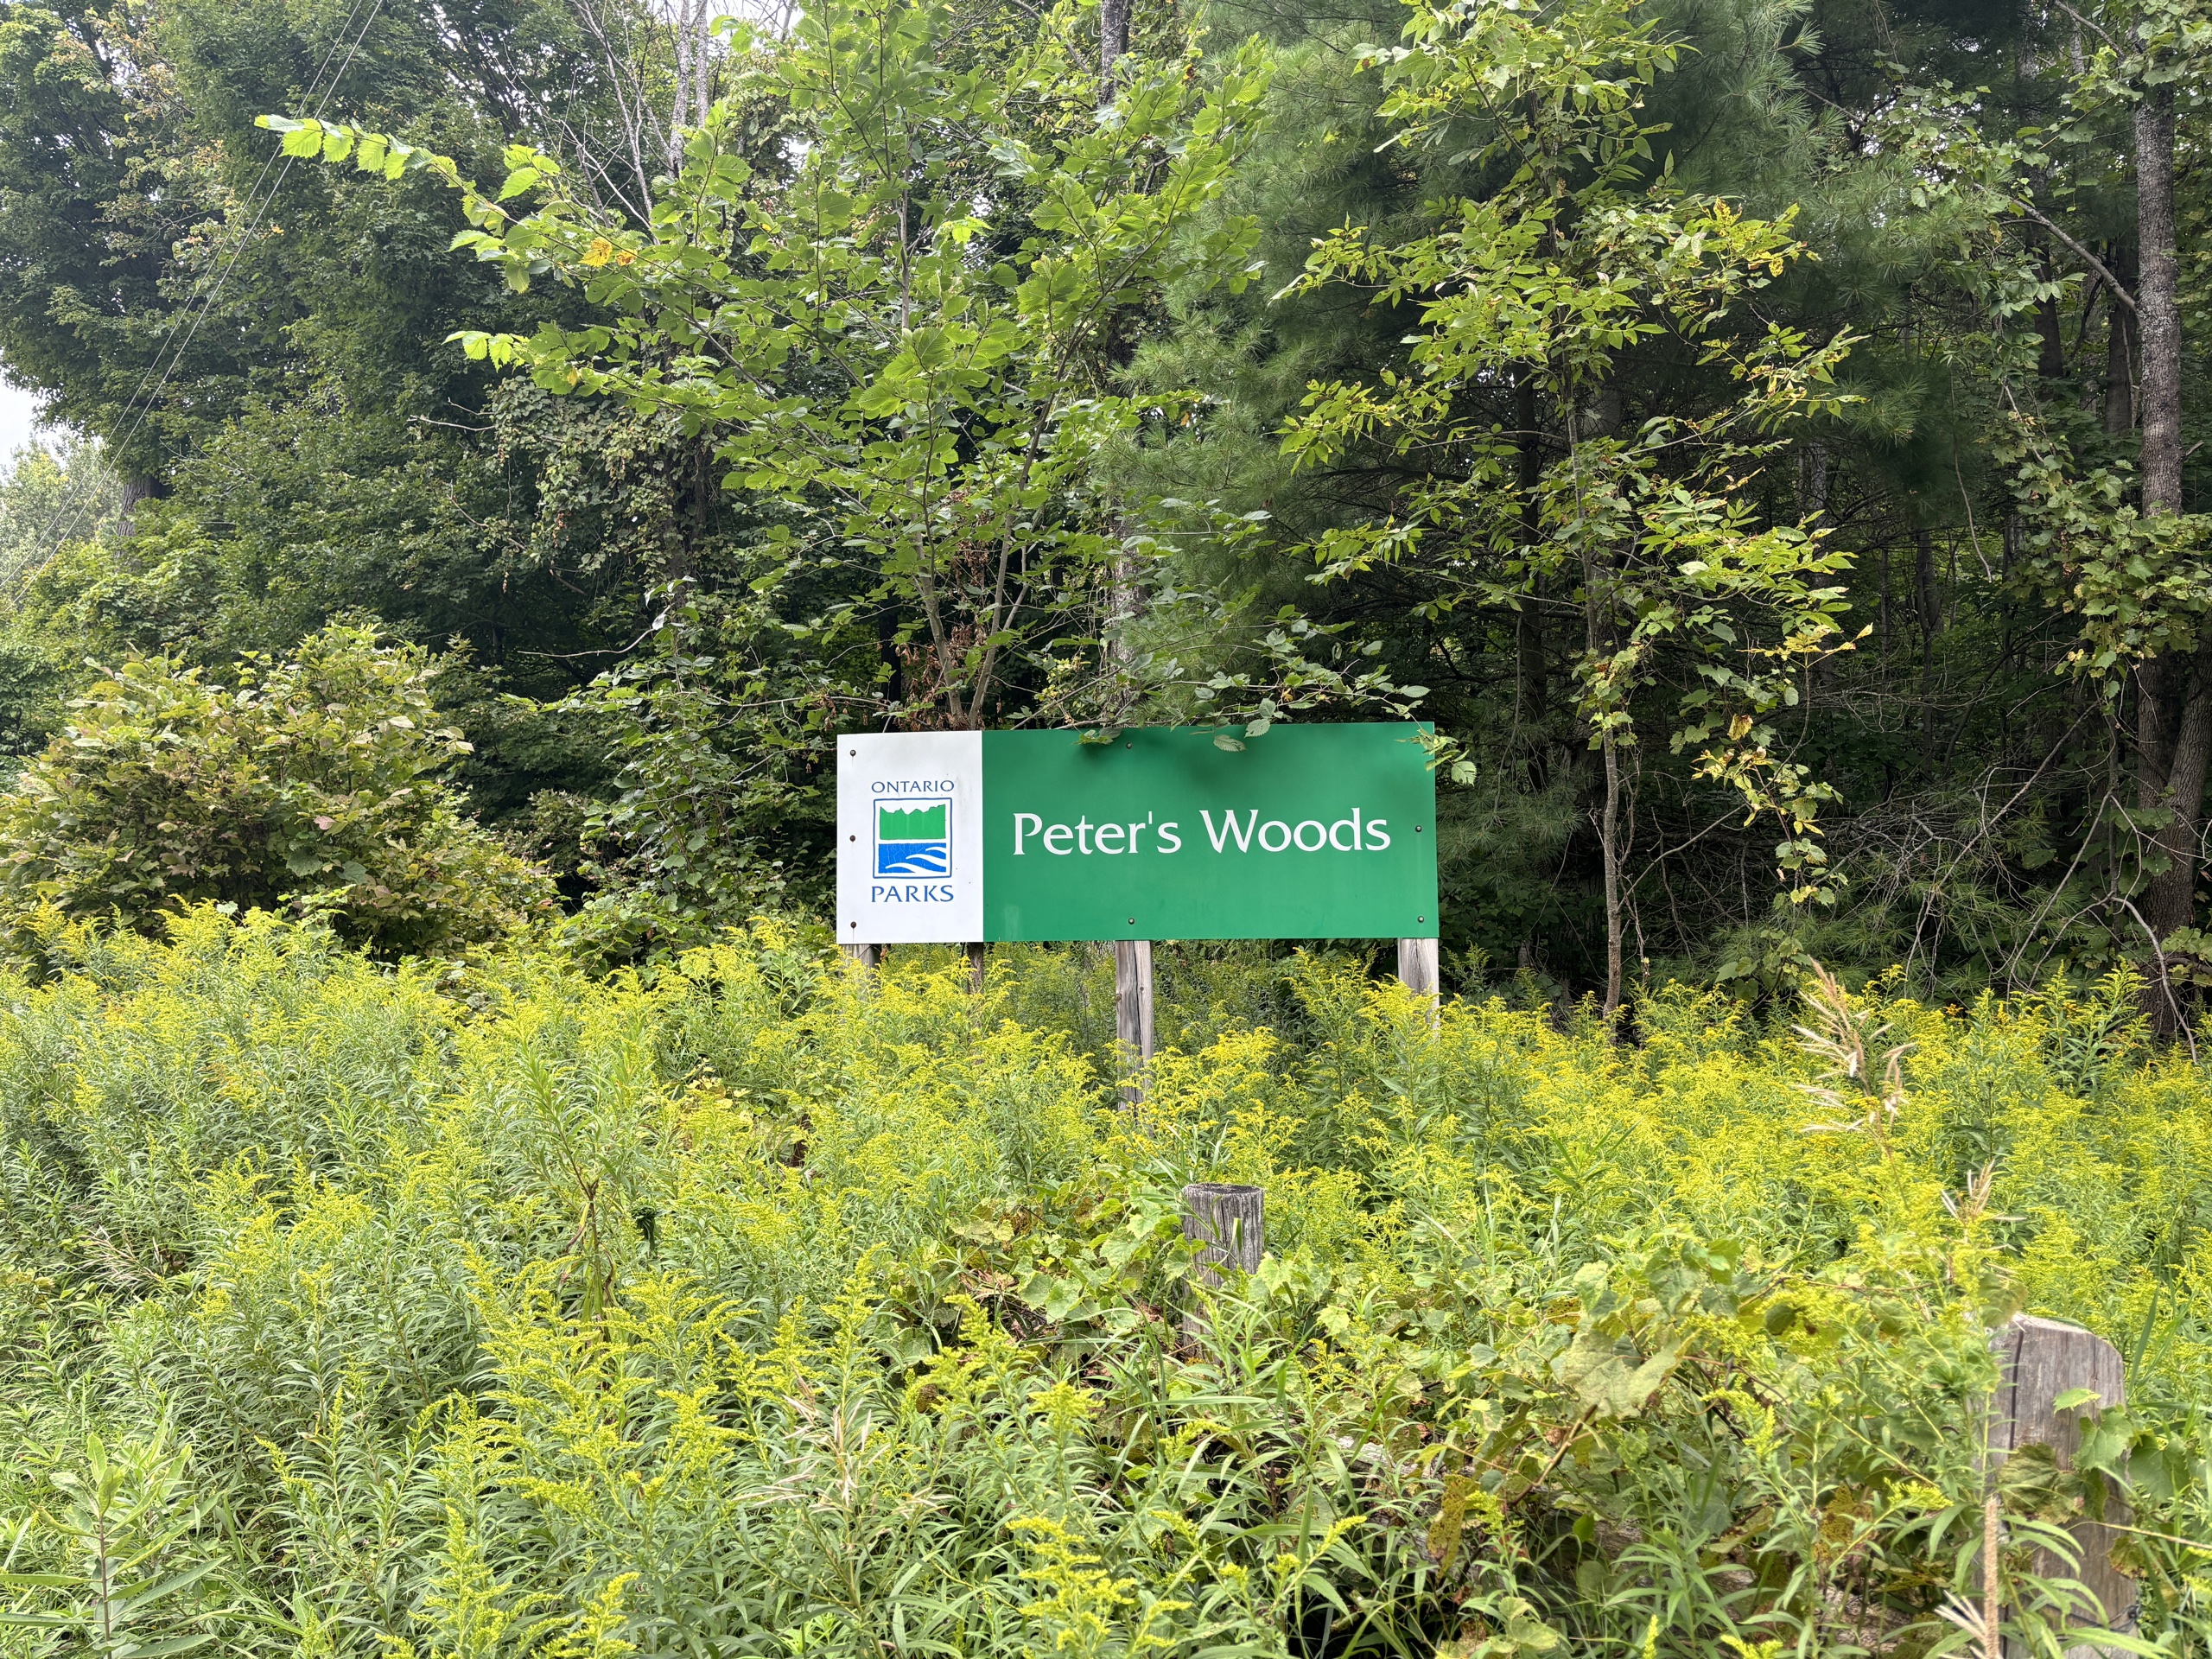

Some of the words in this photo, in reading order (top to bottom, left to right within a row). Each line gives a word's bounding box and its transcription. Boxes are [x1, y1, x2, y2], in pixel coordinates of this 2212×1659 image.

[871, 780, 955, 793] ONTARIO
[1013, 810, 1182, 855] Peter's
[1198, 807, 1391, 854] Woods
[871, 885, 954, 903] PARKS
